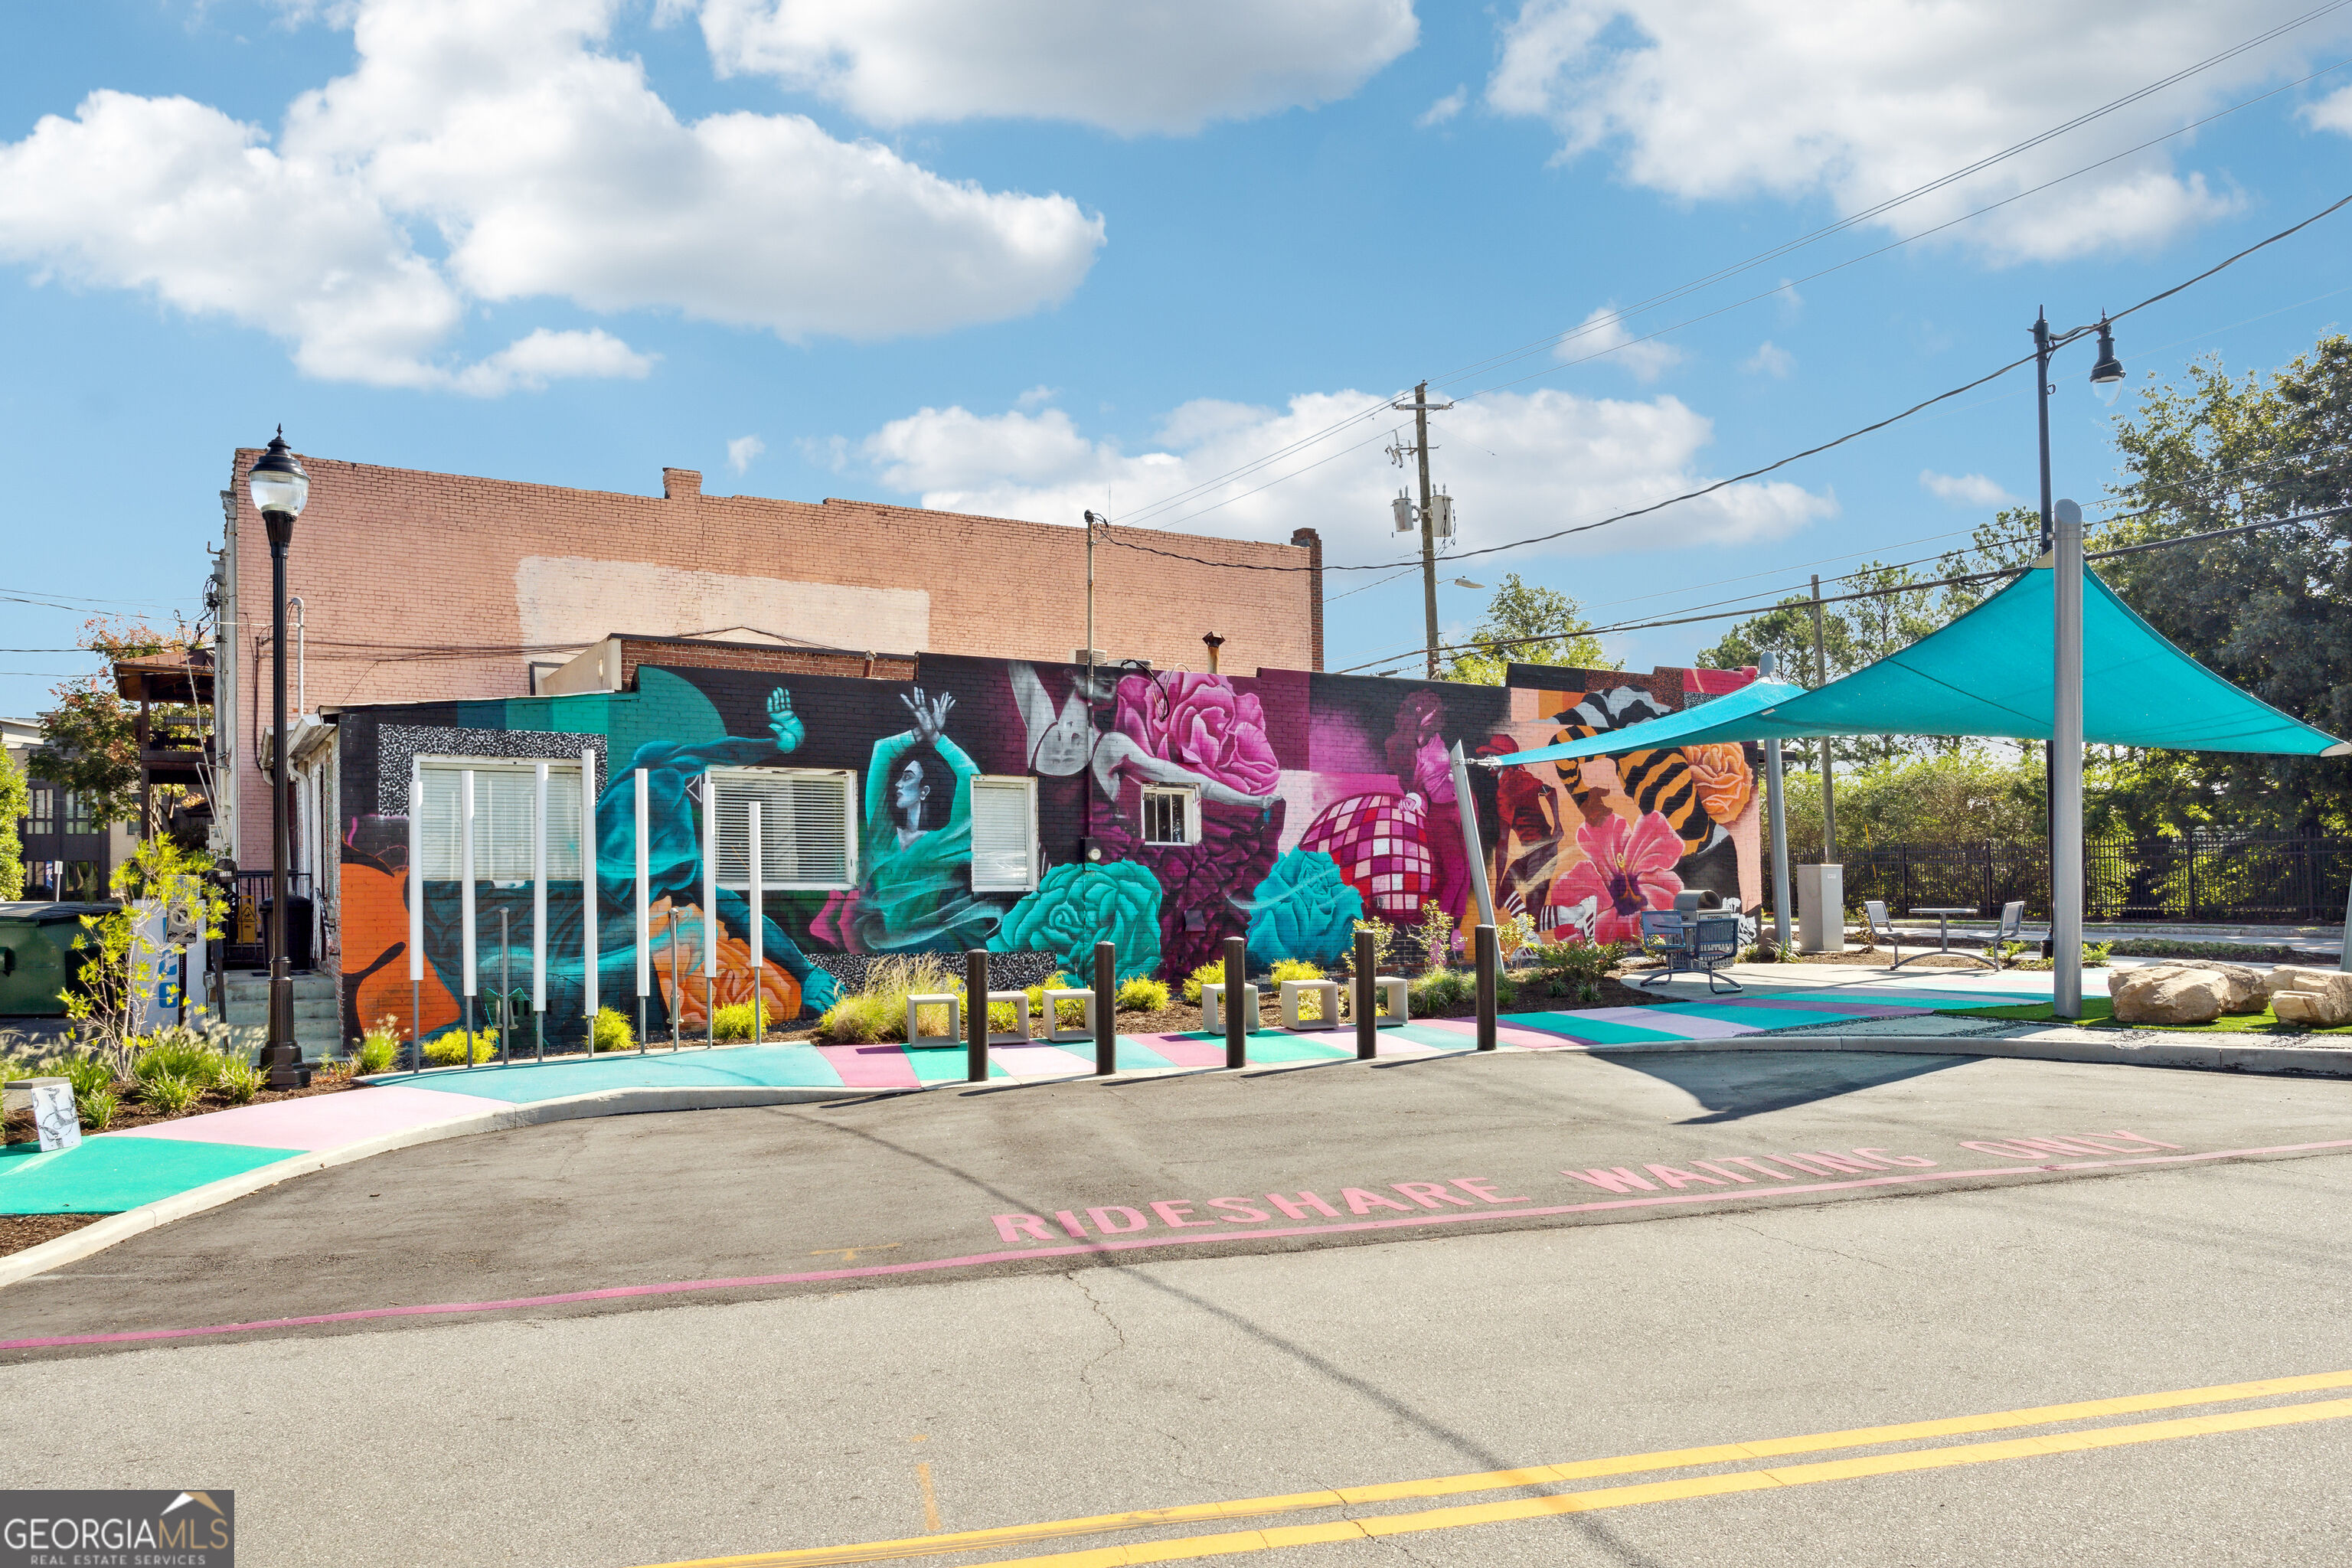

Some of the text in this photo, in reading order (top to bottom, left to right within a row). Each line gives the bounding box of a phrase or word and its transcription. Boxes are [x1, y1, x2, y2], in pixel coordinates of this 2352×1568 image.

[991, 1129, 2185, 1243] RIDESHARE WAITING ONLY
